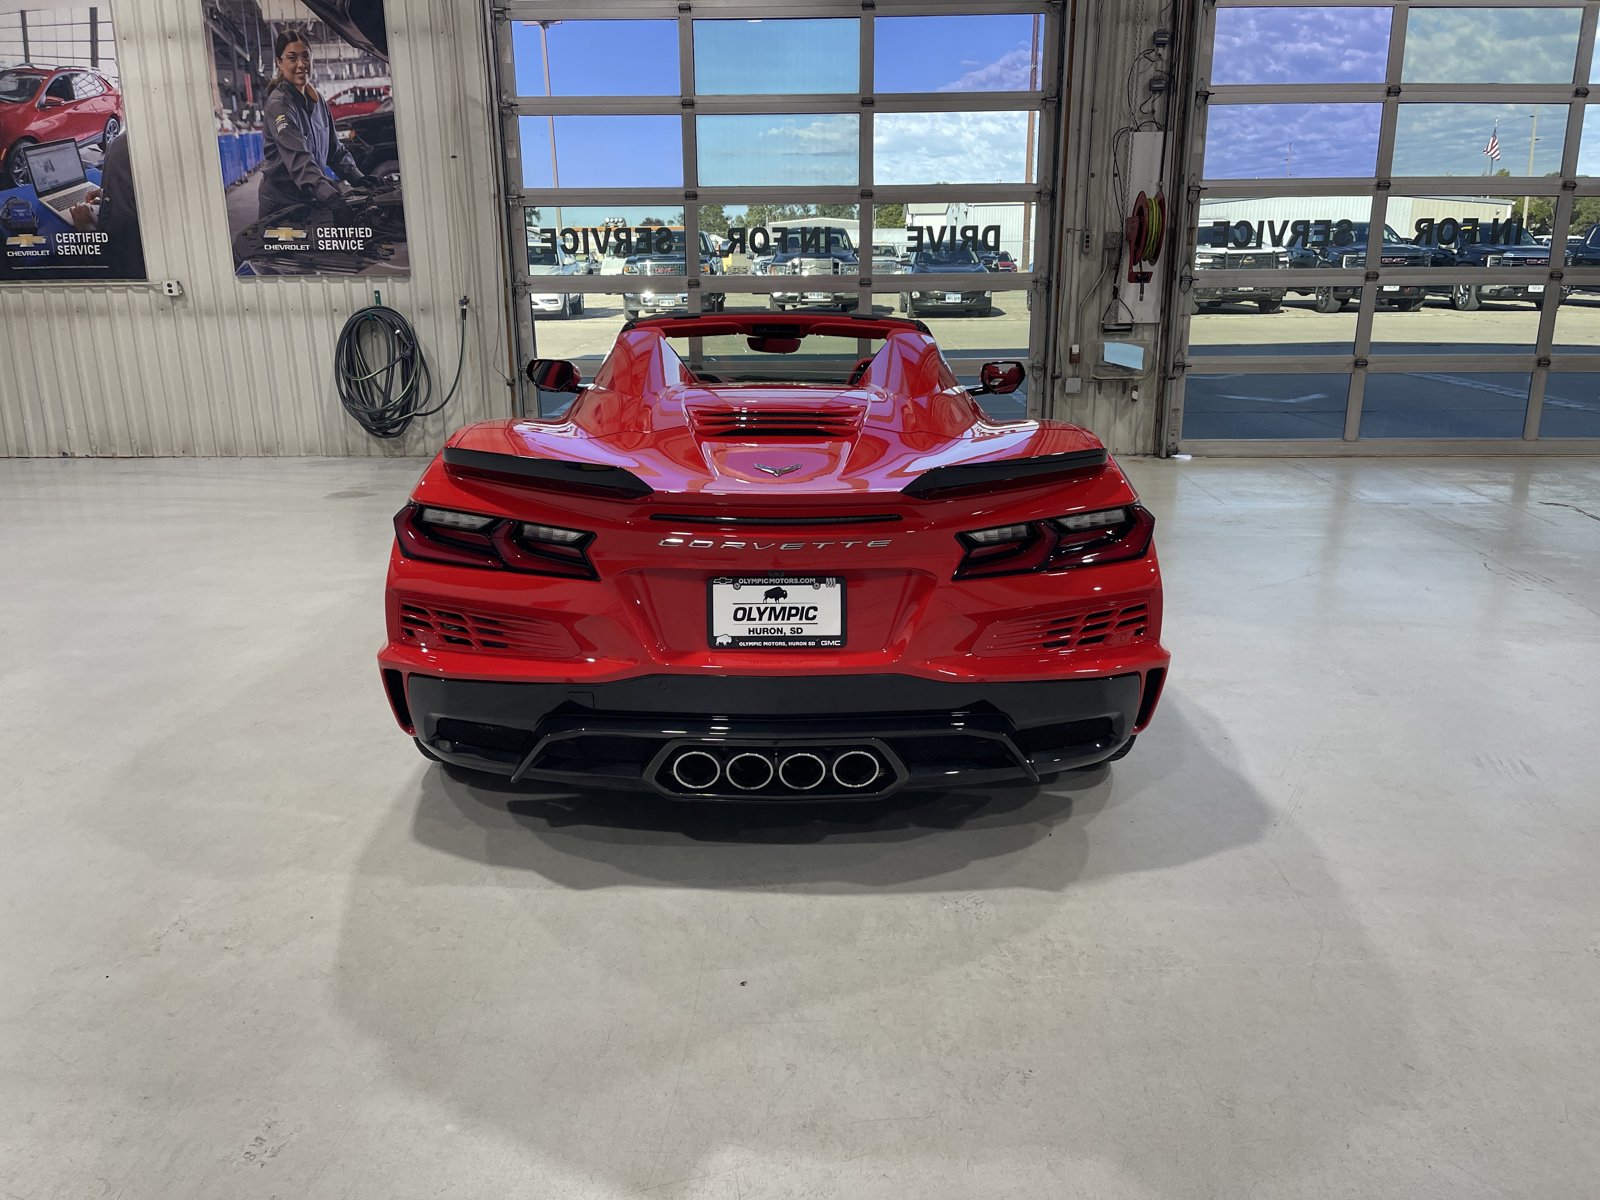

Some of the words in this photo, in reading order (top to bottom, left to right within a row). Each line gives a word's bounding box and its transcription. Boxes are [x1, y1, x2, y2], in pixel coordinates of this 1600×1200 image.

[55, 232, 109, 243] CERTIFIED
[317, 227, 373, 238] CERTIFIED
[57, 244, 101, 255] SERVICE
[318, 240, 365, 250] SERVICE
[7, 249, 50, 257] CHEVROLET
[658, 538, 893, 551] CORVETTE
[733, 606, 818, 622] OLYMPIC
[748, 627, 786, 636] HURON,
[790, 627, 804, 635] SD
